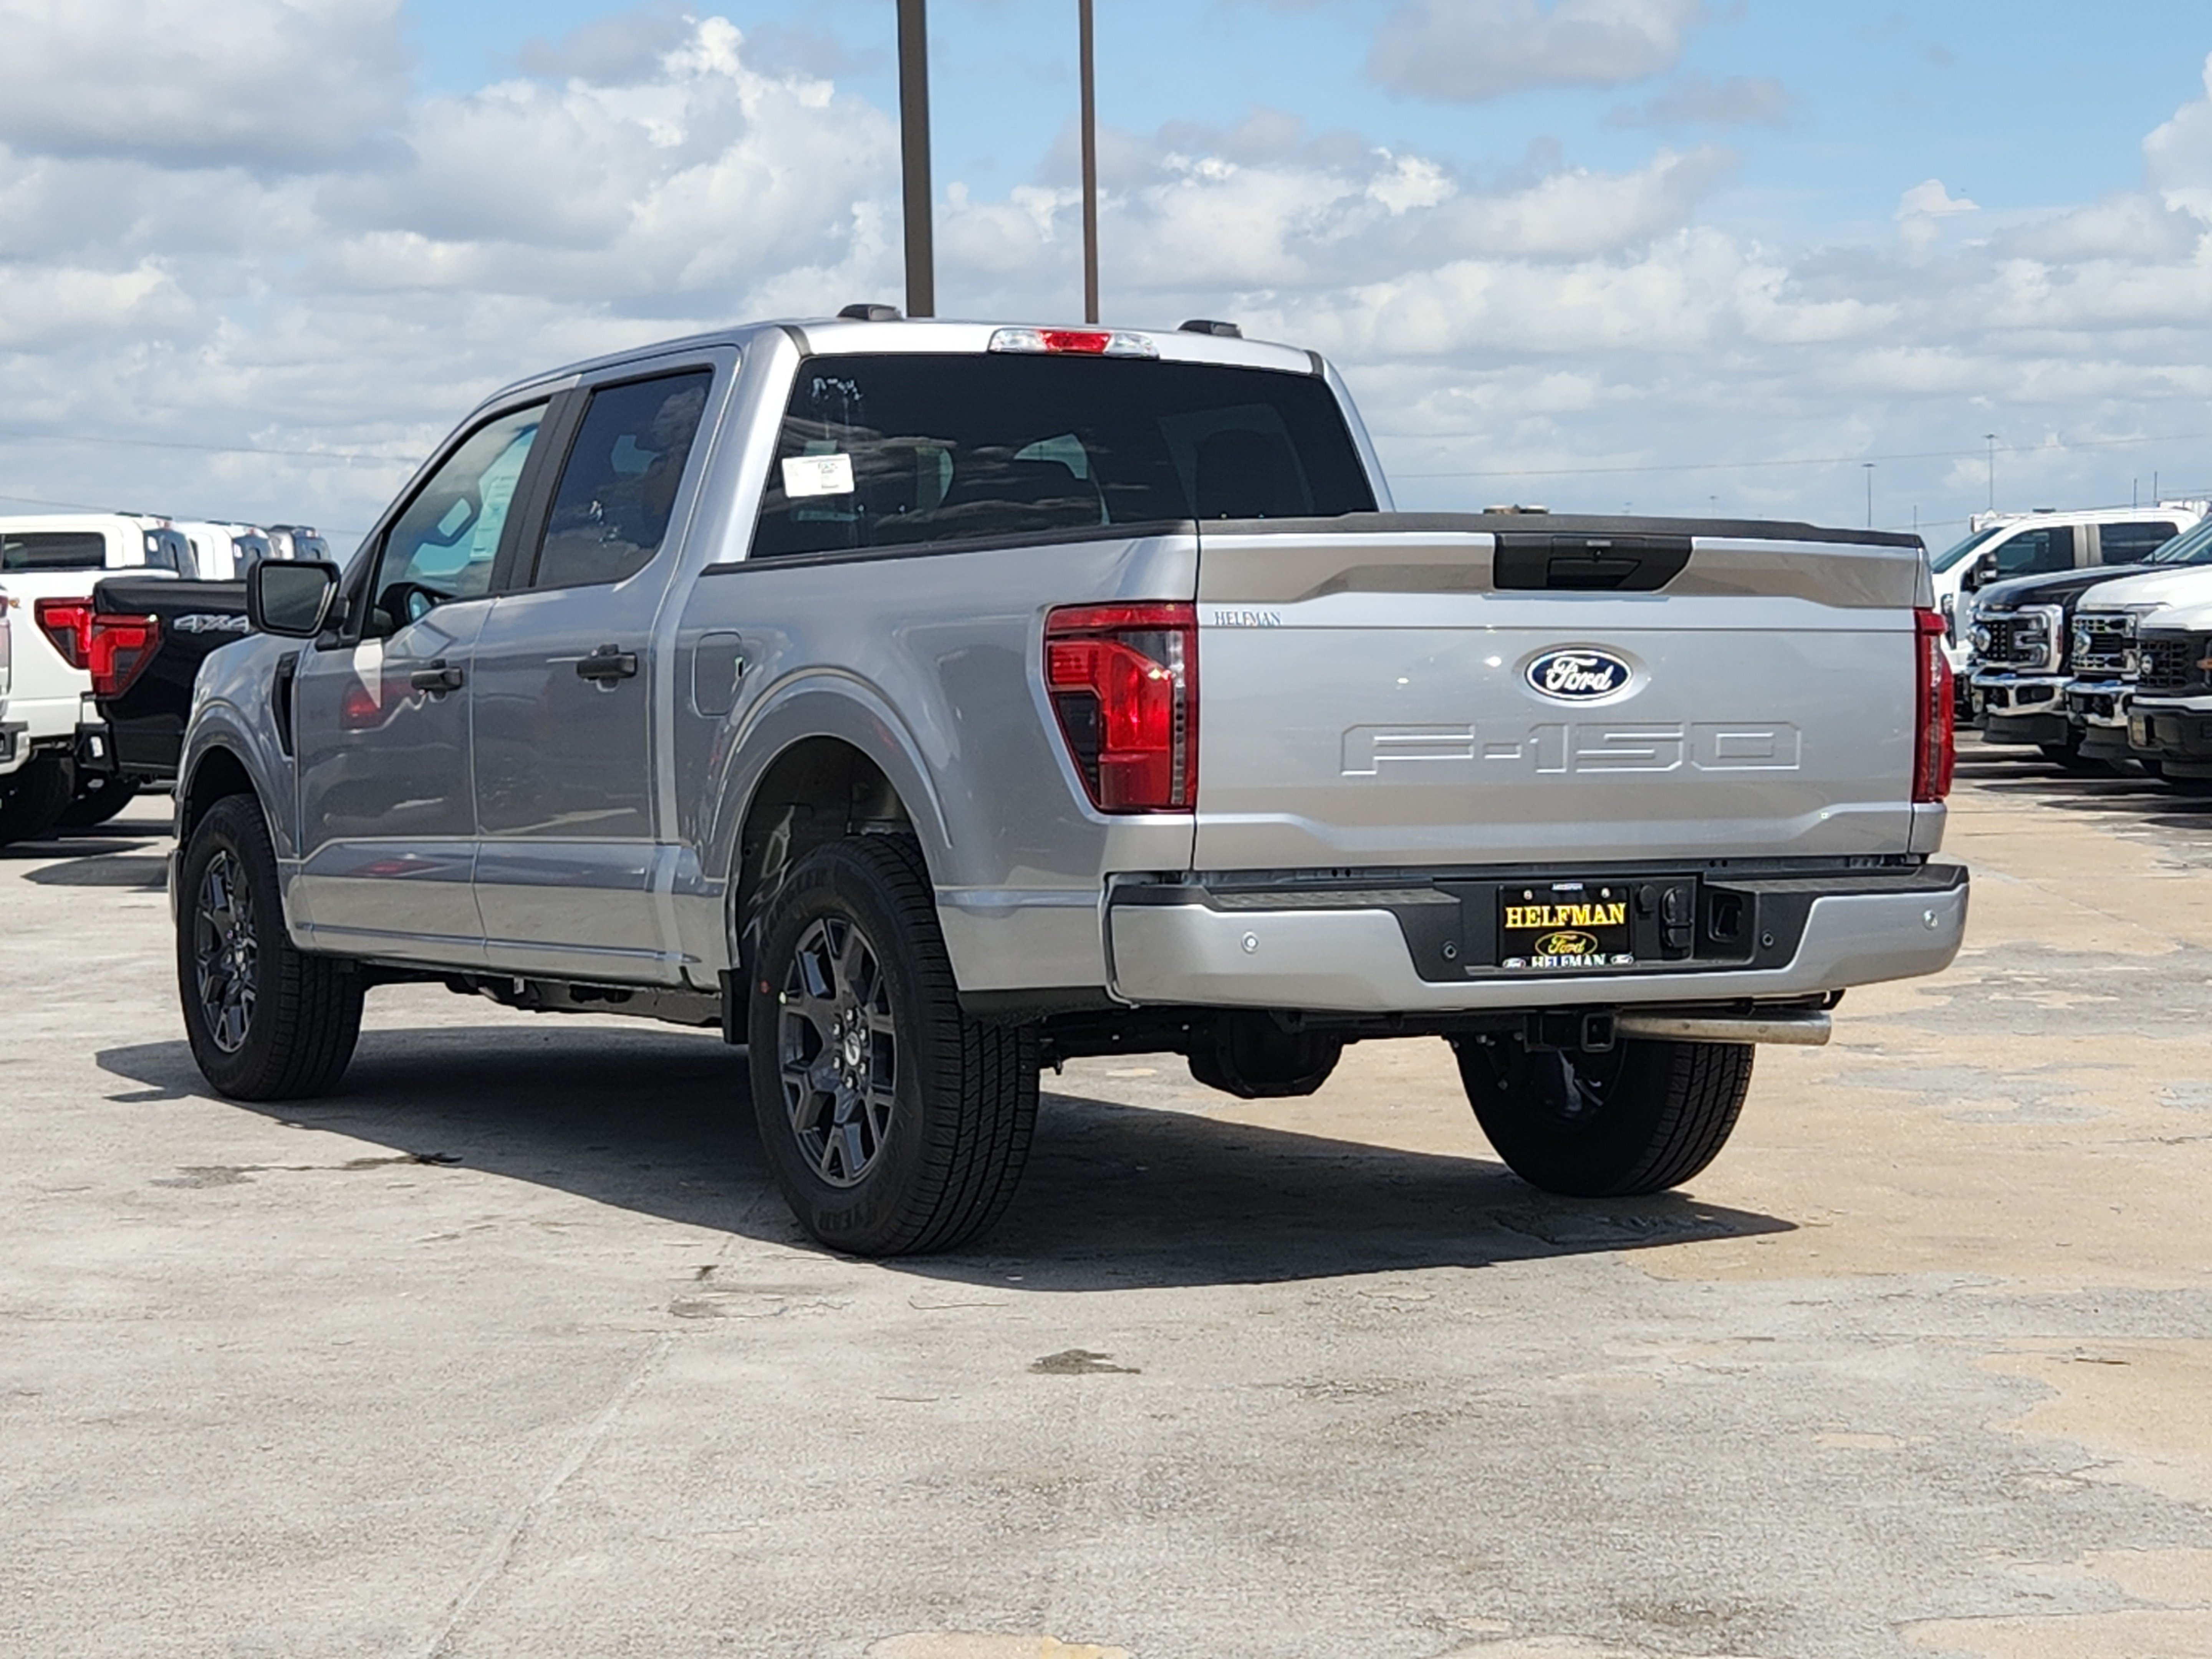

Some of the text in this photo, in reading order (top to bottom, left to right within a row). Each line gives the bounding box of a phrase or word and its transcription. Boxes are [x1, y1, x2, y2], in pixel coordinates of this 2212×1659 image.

[1546, 656, 1614, 690] Ford
[1342, 722, 1802, 776] F-150
[1505, 902, 1627, 928] HELFMAN
[1547, 934, 1587, 954] Ford
